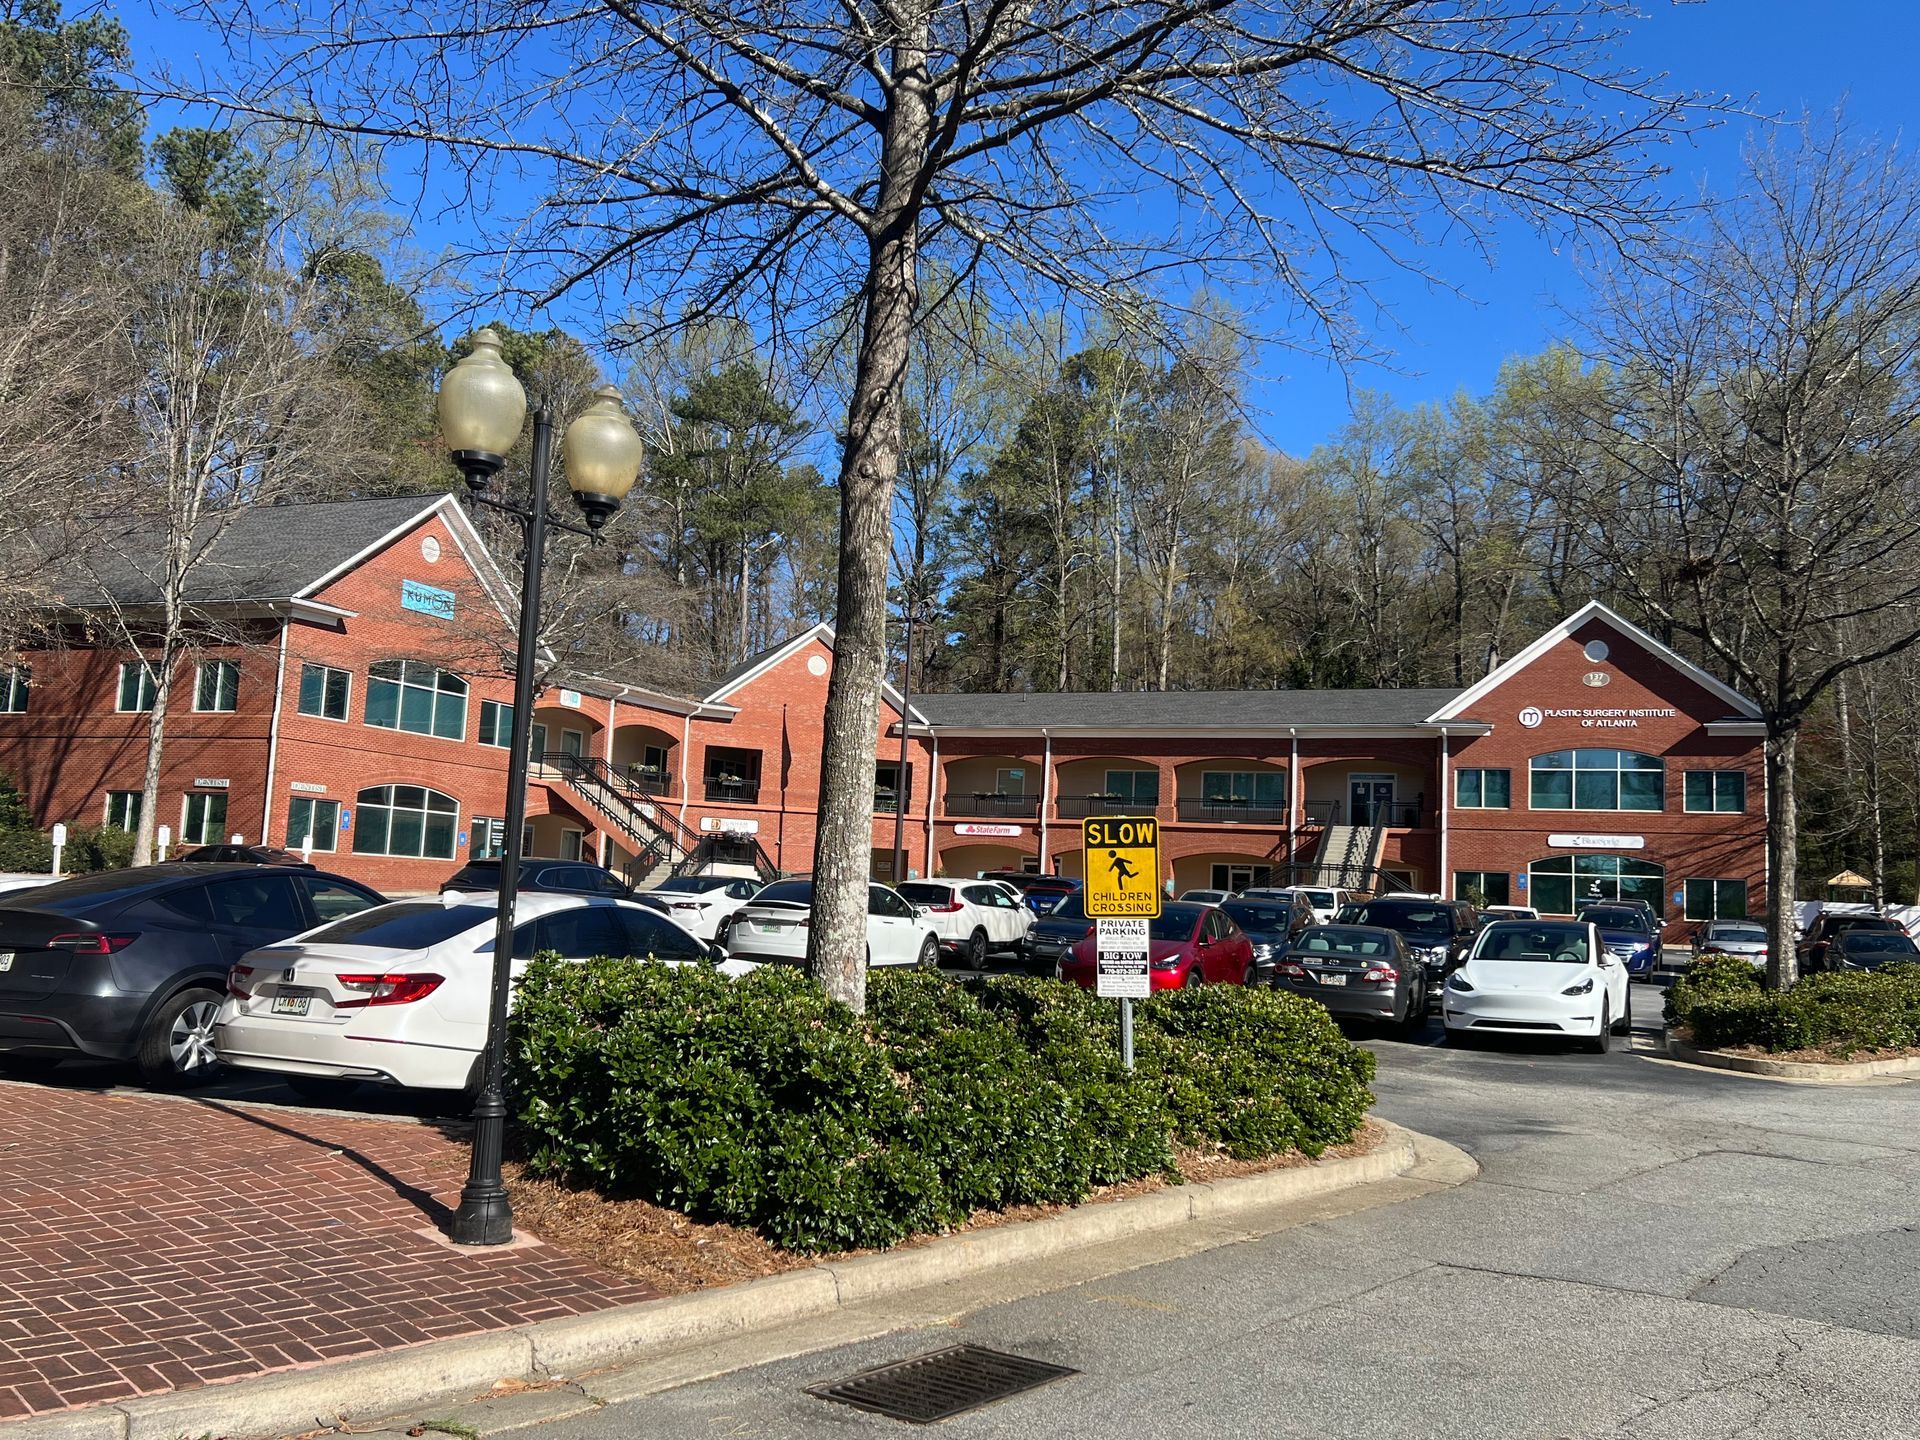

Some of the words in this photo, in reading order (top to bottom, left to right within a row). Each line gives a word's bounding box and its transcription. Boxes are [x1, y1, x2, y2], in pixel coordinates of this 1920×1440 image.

[406, 589, 452, 611] KUMON
[1544, 709, 1582, 717] PLASTIC
[1582, 709, 1628, 717] SURGERY
[1629, 709, 1676, 717] INSTITUTE
[1581, 719, 1595, 727] OF
[1596, 719, 1638, 727] ATLANTA
[1087, 823, 1154, 845] SLOW
[1093, 892, 1152, 901] CHILDREN
[1093, 903, 1152, 913] CROSSING
[1101, 920, 1144, 928] PRIVATE
[1099, 928, 1146, 936] PARKING
[1103, 951, 1120, 960] BIG
[1120, 951, 1143, 960] TOW
